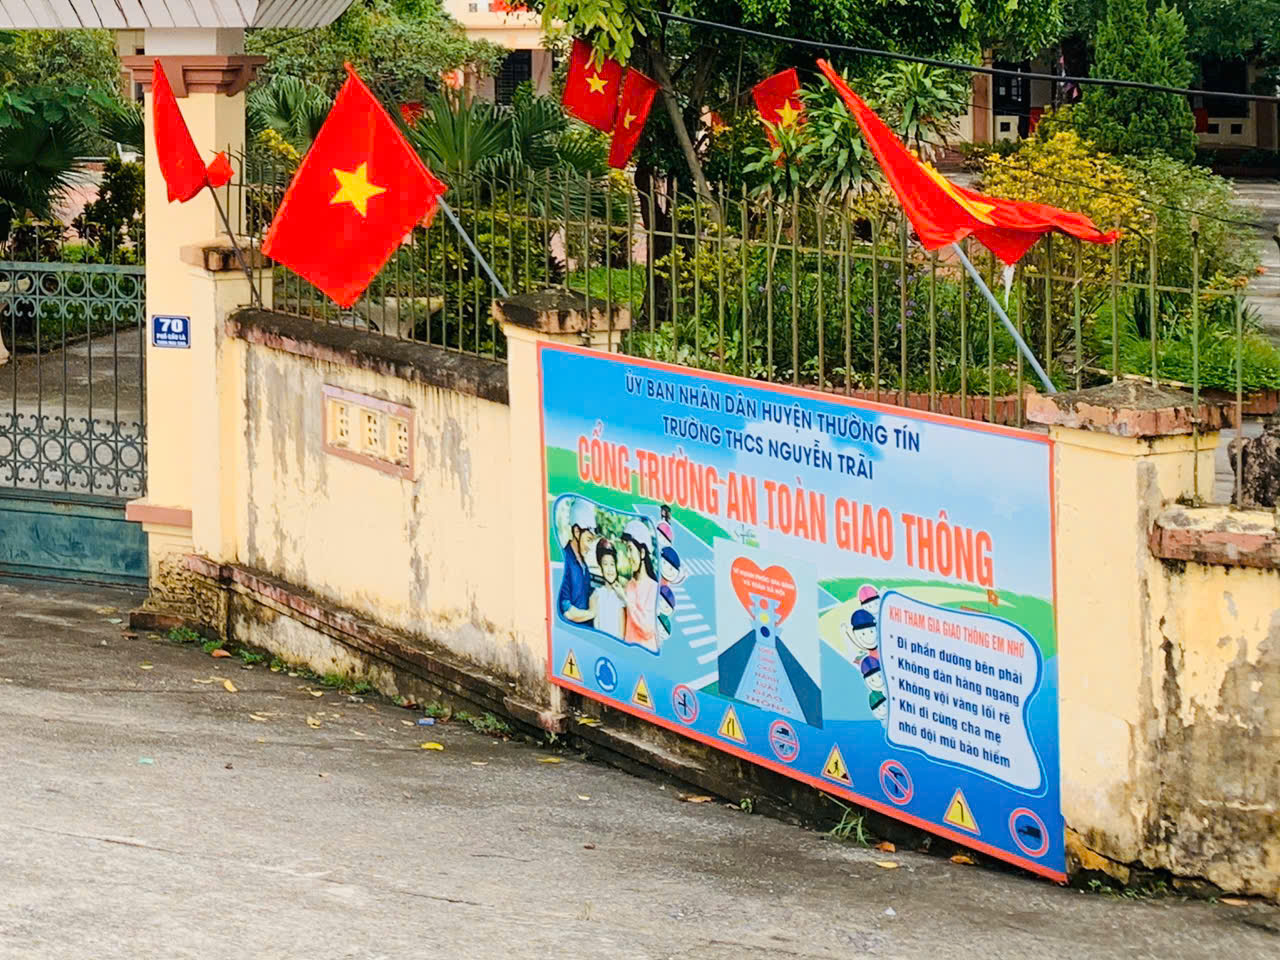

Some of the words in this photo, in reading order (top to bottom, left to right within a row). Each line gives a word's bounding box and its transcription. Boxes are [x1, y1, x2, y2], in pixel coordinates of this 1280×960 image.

[159, 318, 183, 333] 70
[646, 379, 674, 402] BAN
[679, 384, 720, 411] NHÂN
[725, 391, 757, 418] DÂN
[762, 402, 812, 433] HUYỆN
[817, 412, 888, 445] THƯỜNG
[894, 423, 920, 452] TÍN
[663, 415, 721, 445] TRƯỜNG
[726, 429, 763, 456] THCS
[770, 440, 832, 471] NGUYỄN
[838, 453, 873, 480] TRÃI
[578, 419, 631, 492] CỔNG
[636, 445, 719, 516] TRƯỜNG
[727, 471, 758, 526] AN
[764, 476, 827, 544] TOÀN
[835, 497, 894, 561] GIAO
[902, 509, 994, 588] THÔNG
[888, 605, 902, 623] KHI
[904, 610, 925, 631] THAM
[928, 616, 941, 634] GIA
[943, 619, 961, 640] GIAO
[963, 625, 990, 649] THÔNG
[992, 635, 1005, 653] EM
[897, 636, 908, 650] Đi
[975, 659, 995, 677] bên
[999, 667, 1023, 685] phải
[897, 657, 930, 679] Không
[933, 667, 953, 684] dàn
[956, 676, 982, 696] hàng
[985, 686, 1020, 707] ngang
[898, 678, 931, 700] Không
[934, 691, 949, 706] vội
[953, 696, 978, 716] vàng
[899, 698, 916, 715] Khi
[932, 711, 958, 730] cùng
[961, 721, 981, 737] cha
[984, 728, 1002, 746] mẹ
[940, 734, 956, 749] mũ
[960, 740, 979, 758] bảo
[983, 748, 1011, 769] hiểm
